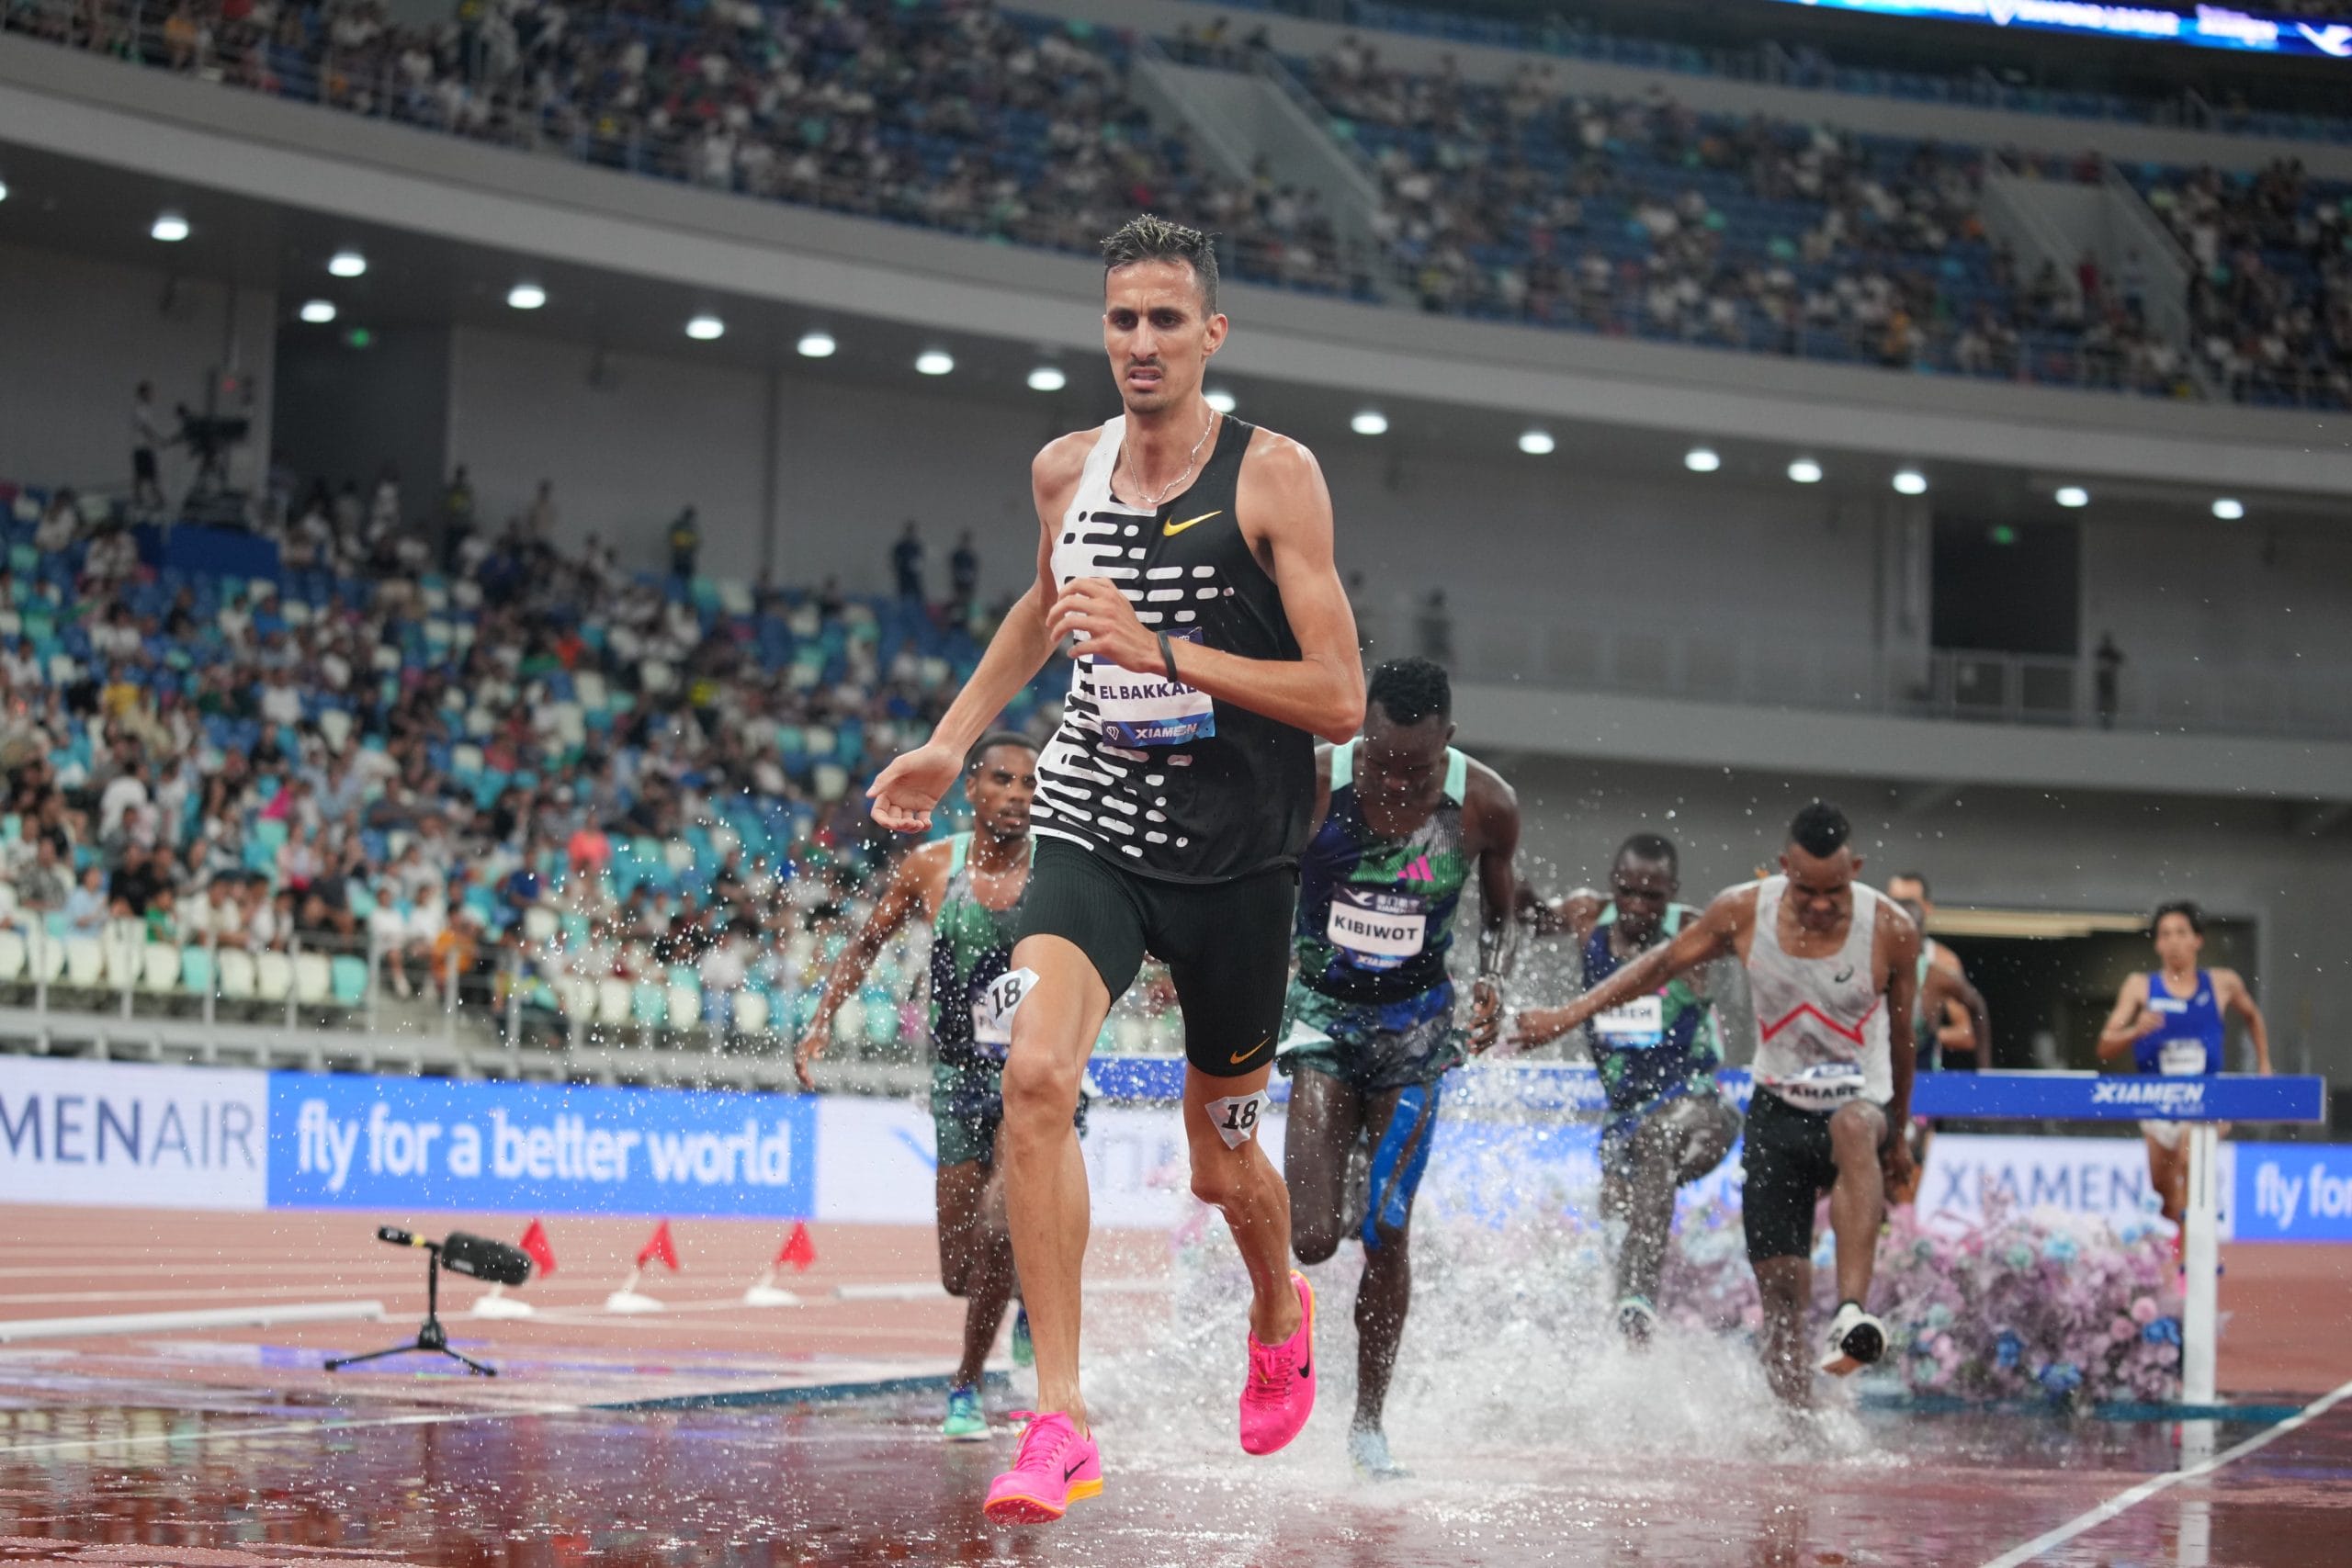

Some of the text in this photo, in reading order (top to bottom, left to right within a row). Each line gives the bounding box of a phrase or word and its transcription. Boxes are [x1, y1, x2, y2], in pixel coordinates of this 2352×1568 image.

[1136, 724, 1197, 739] XIAMEN
[1335, 915, 1418, 940] KIBIWOT
[992, 977, 1021, 1021] 18
[2093, 1082, 2204, 1104] XIAMEN
[1222, 1100, 1259, 1130] 18
[299, 1099, 791, 1192] fly for a better world
[2256, 1162, 2302, 1230] fly
